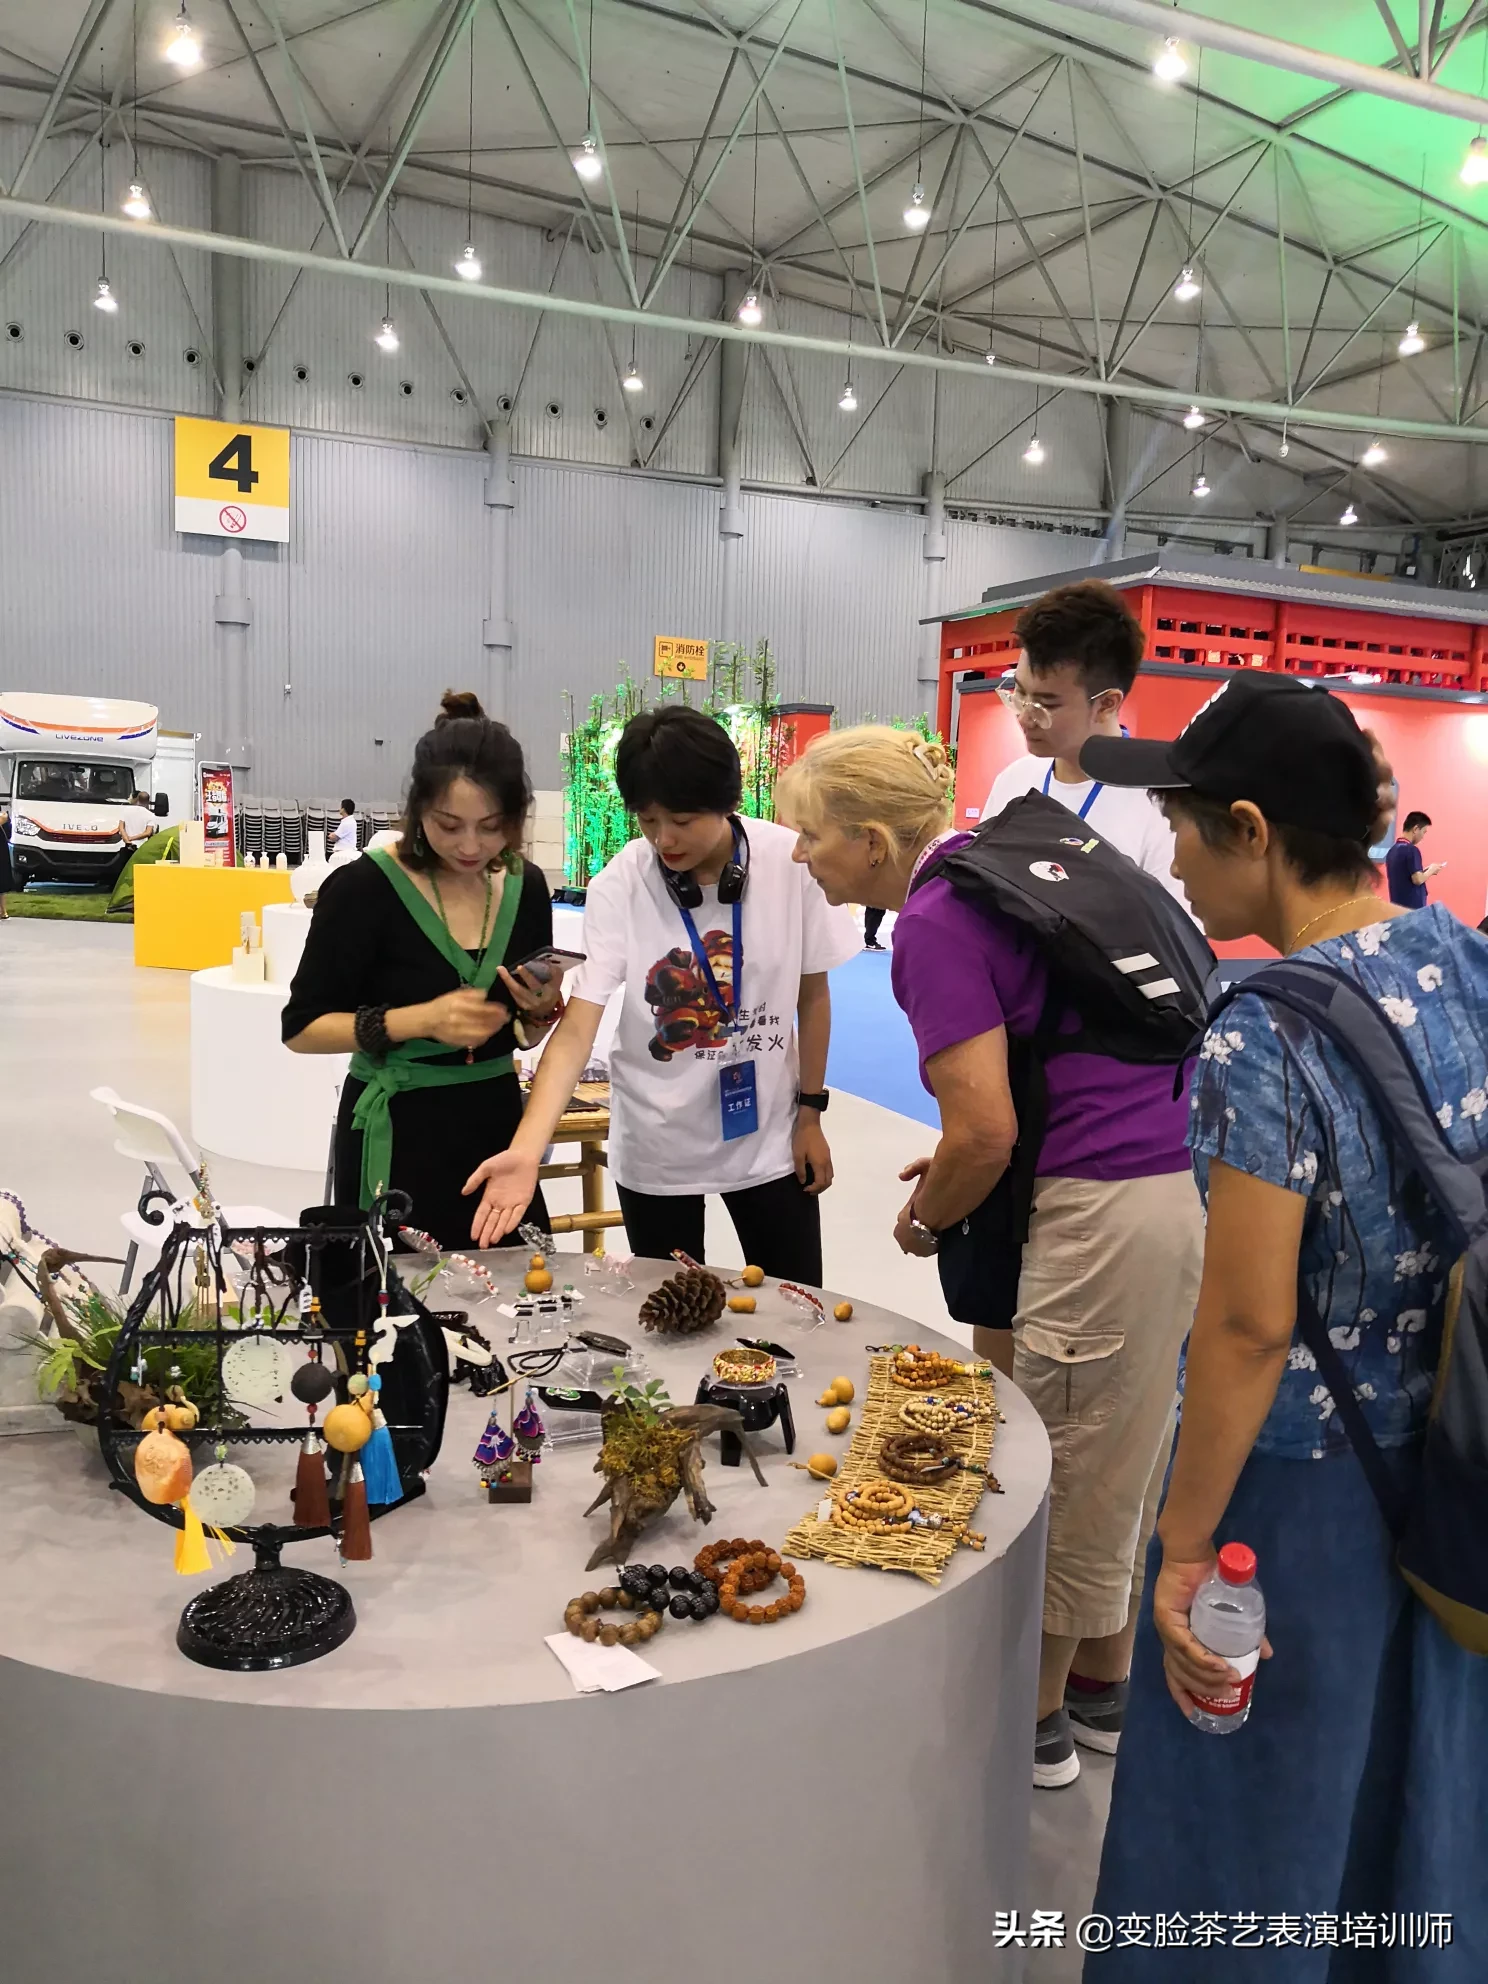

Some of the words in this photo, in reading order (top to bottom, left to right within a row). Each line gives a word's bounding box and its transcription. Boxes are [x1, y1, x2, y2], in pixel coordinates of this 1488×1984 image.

[208, 433, 259, 493] 4
[675, 643, 705, 656] 消防栓
[55, 733, 104, 742] LIVEZONE
[747, 1034, 784, 1051] 发火
[727, 1097, 752, 1112] 工作证
